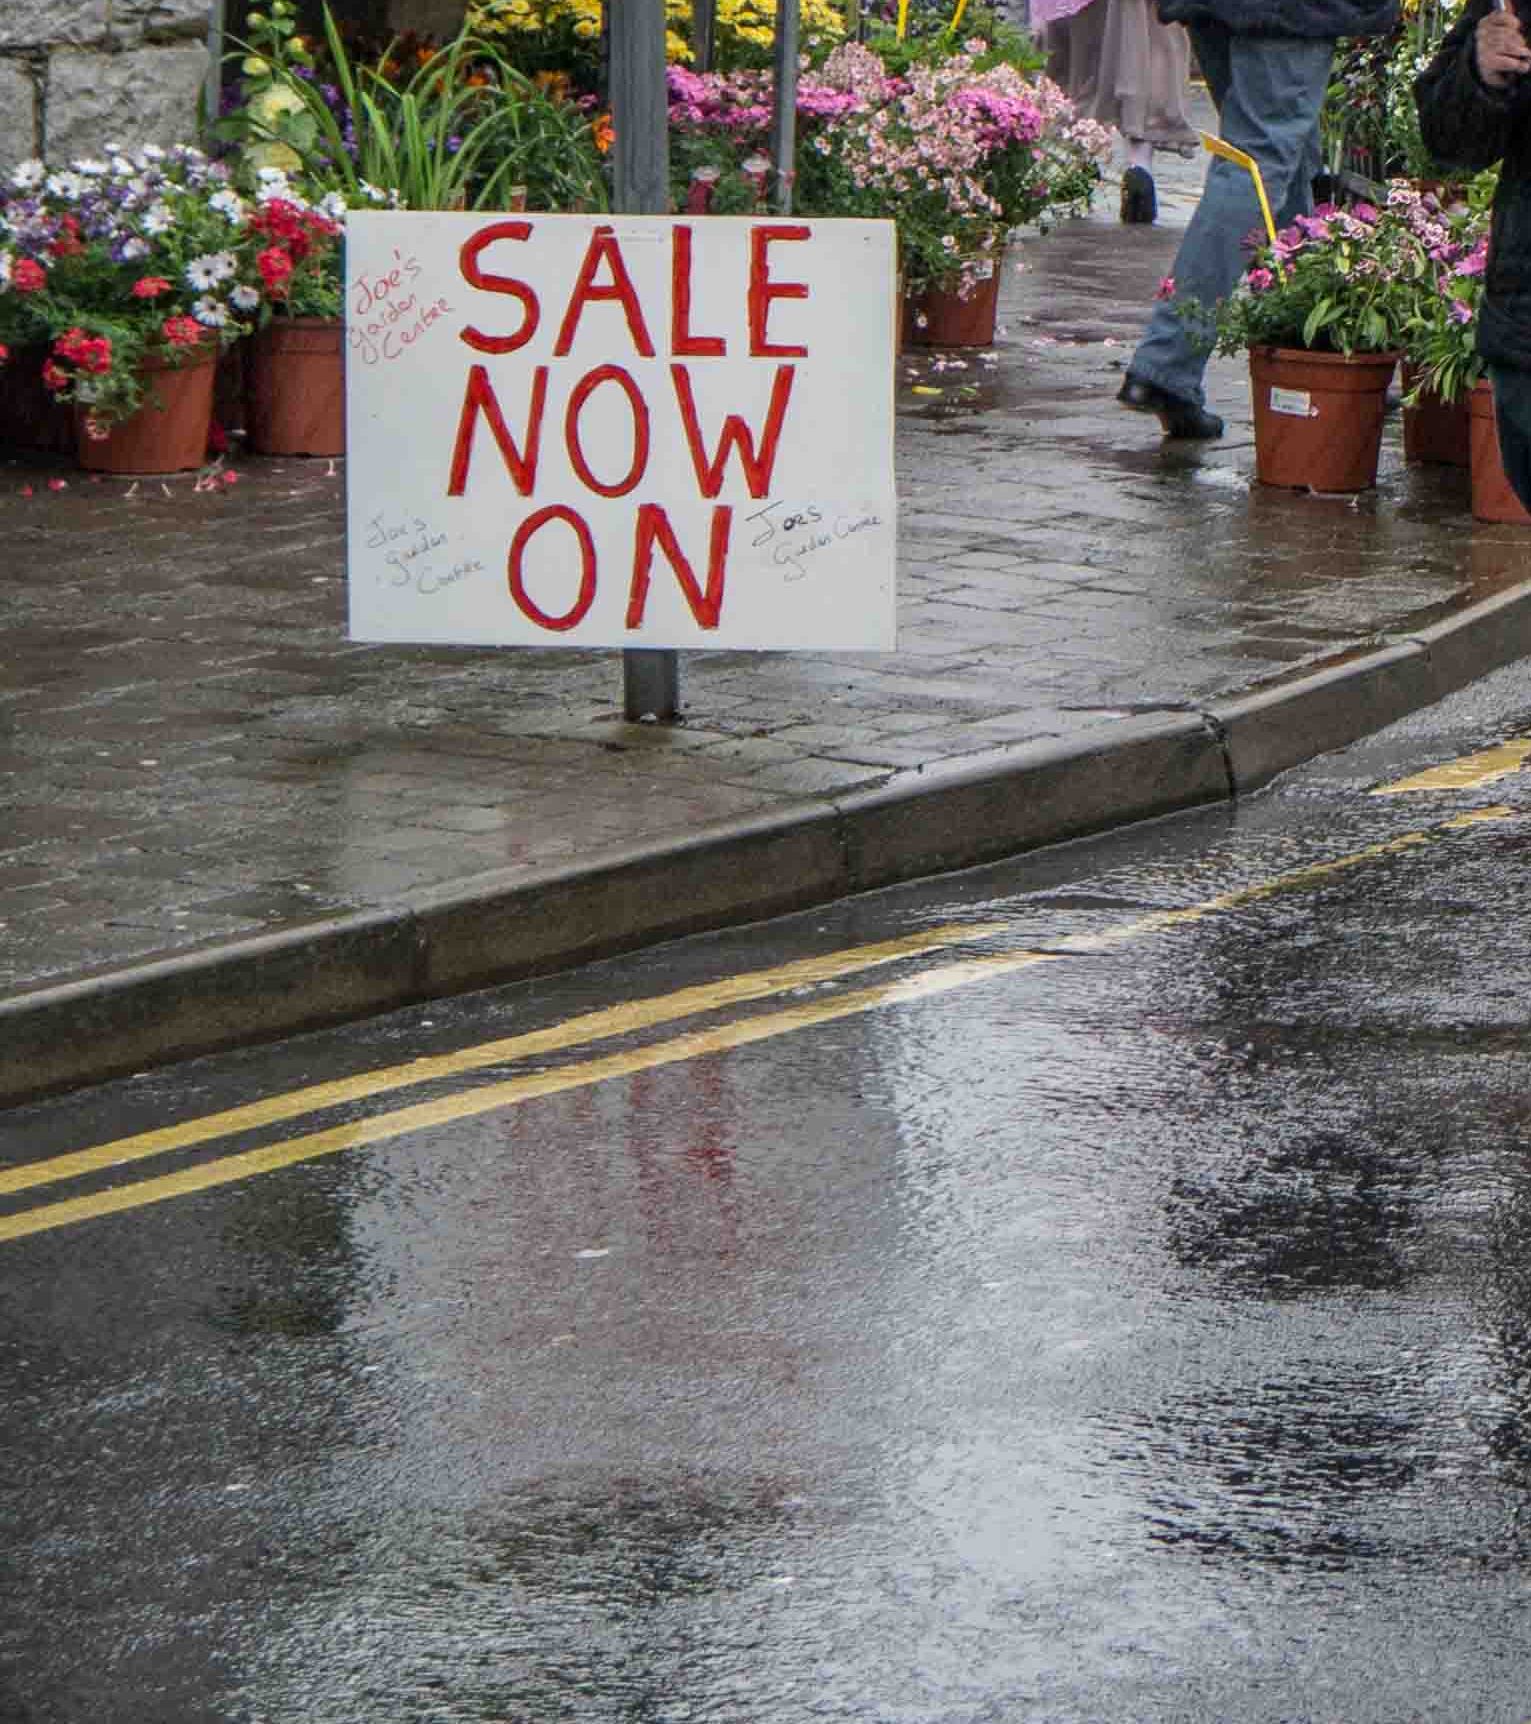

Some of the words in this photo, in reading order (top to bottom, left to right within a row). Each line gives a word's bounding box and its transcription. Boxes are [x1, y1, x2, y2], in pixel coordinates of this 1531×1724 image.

[352, 249, 421, 315] Joe's
[459, 221, 812, 357] SALE
[447, 364, 795, 500] NOW
[508, 503, 734, 632] ON
